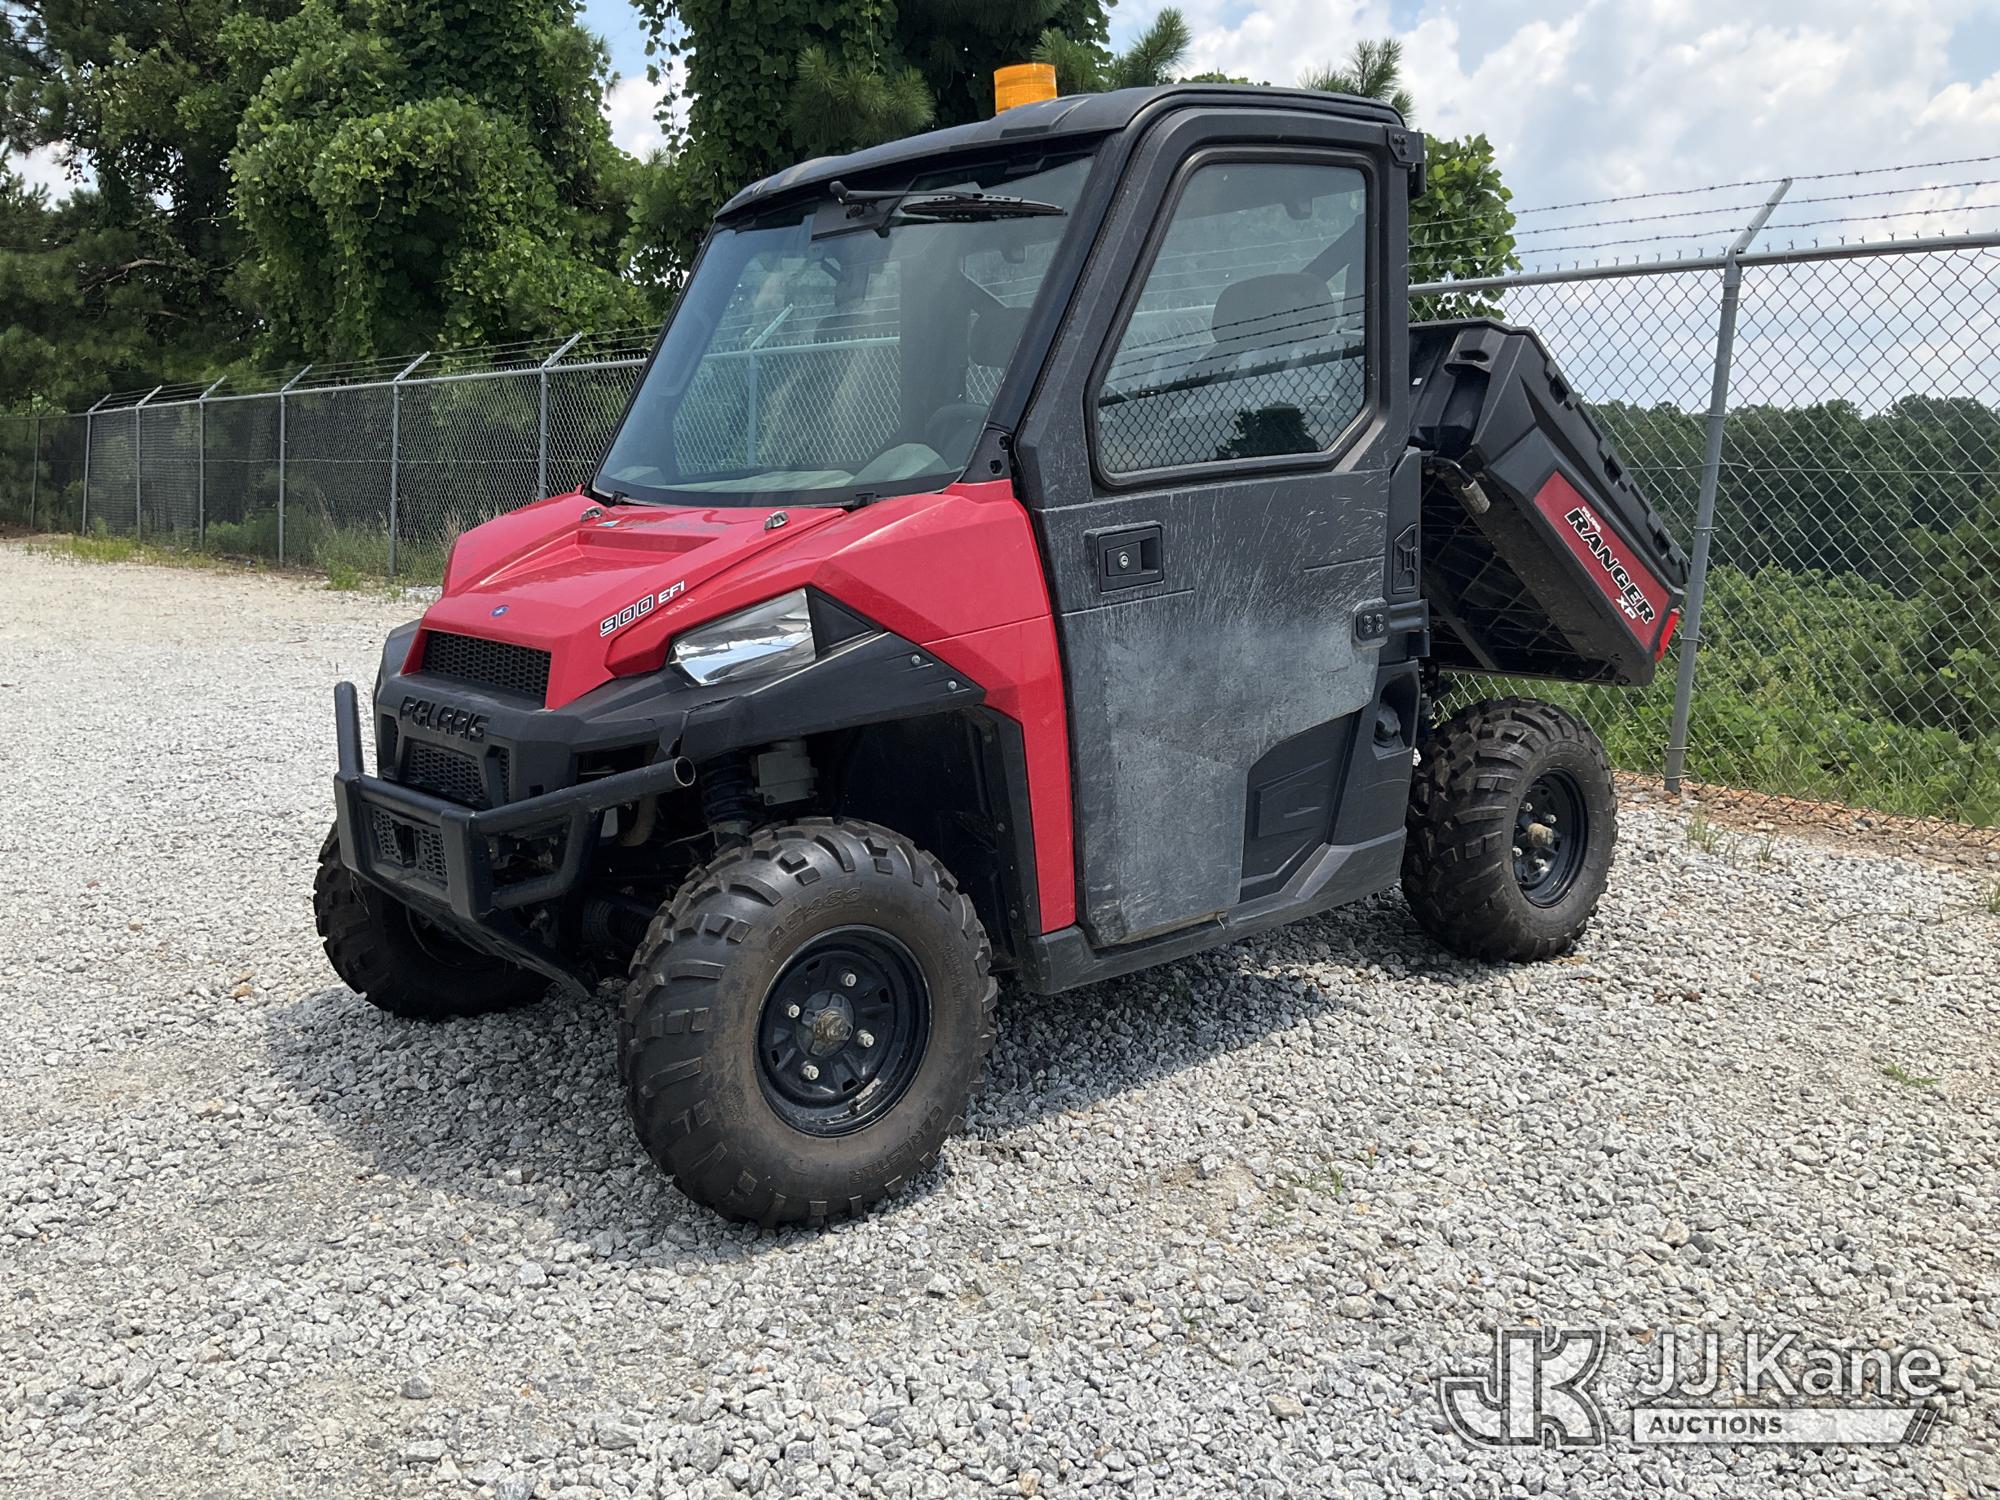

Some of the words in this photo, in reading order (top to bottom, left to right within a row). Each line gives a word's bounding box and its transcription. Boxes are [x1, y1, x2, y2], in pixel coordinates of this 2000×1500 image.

[1564, 507, 1655, 625] RANGER
[600, 594, 654, 637] 900
[658, 580, 685, 605] EFI
[1615, 595, 1637, 620] XP
[400, 696, 491, 741] POLARIS
